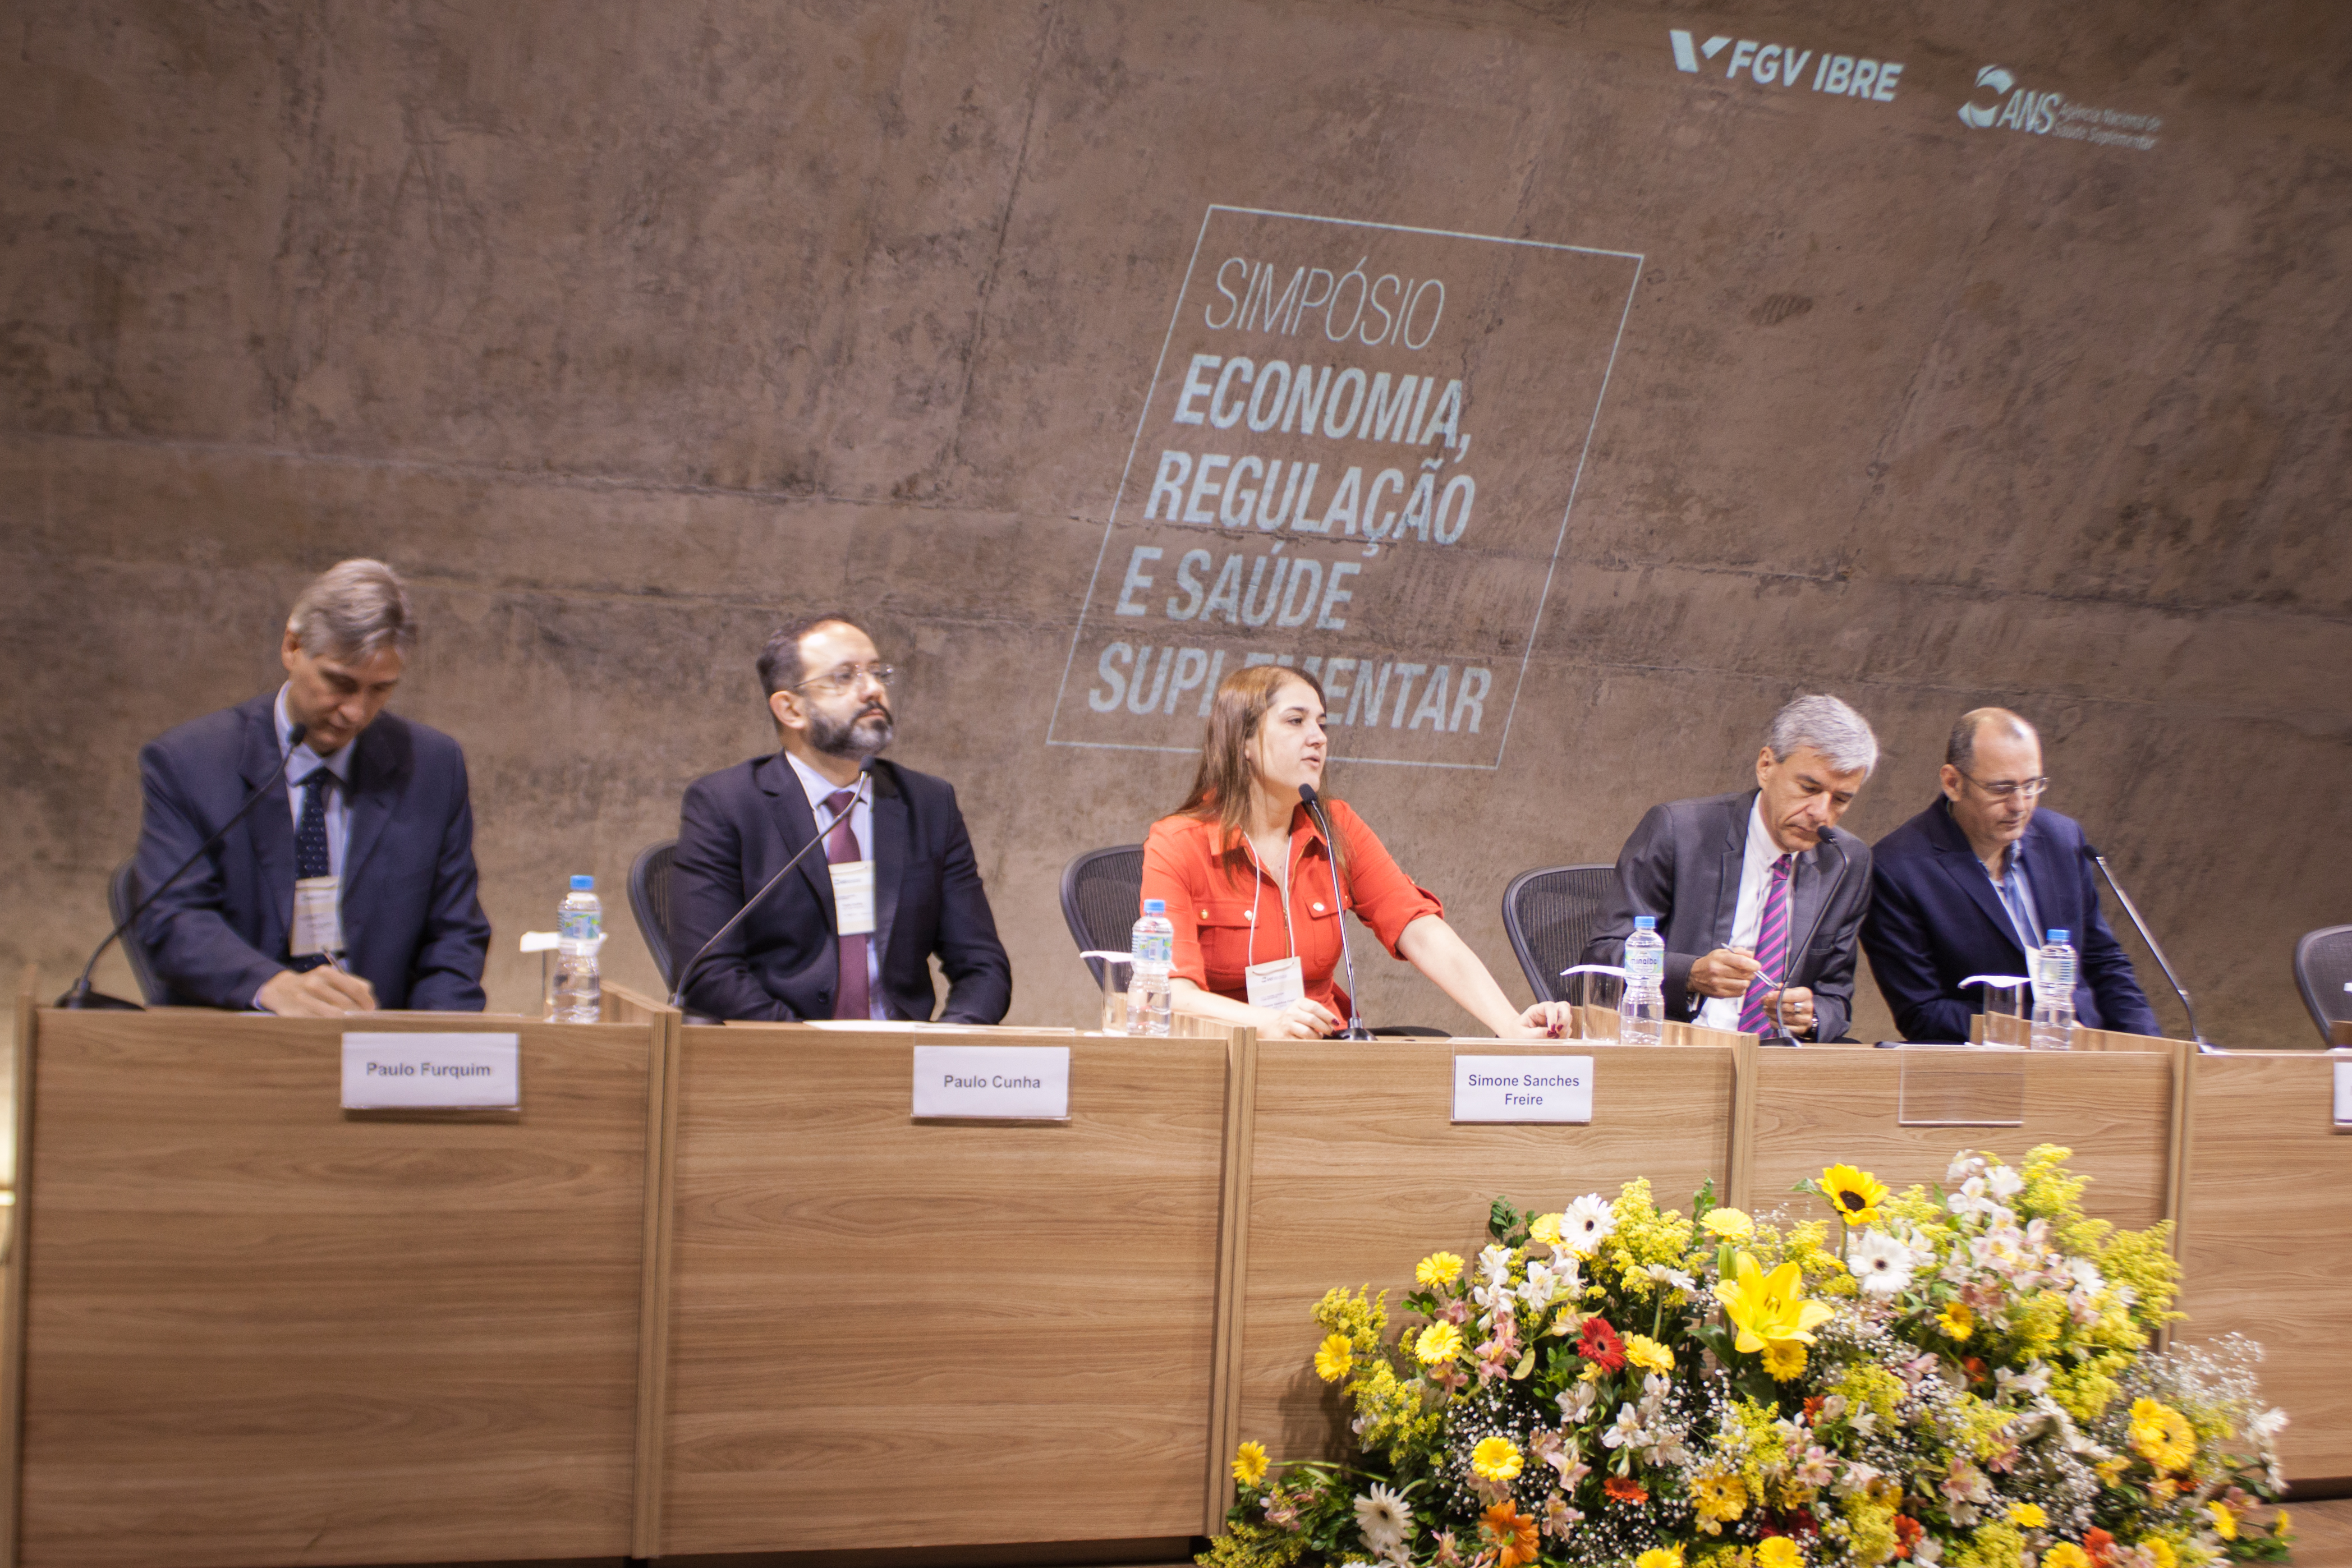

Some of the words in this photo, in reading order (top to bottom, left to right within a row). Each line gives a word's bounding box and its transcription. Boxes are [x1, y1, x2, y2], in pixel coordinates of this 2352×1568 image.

[1726, 40, 1812, 87] FGV
[1813, 53, 1904, 101] IBRE
[1996, 88, 2062, 134] ANS
[1205, 257, 1445, 350] SIMPÓSIO
[1173, 353, 1471, 462] ECONOMIA,
[1144, 450, 1476, 557] REGULAÇÃO
[1115, 545, 1163, 616] E
[1165, 540, 1361, 629] SAÚDE
[366, 1061, 414, 1076] Paulo
[420, 1061, 491, 1079] Furquim
[944, 1075, 987, 1088] Paulo
[992, 1075, 1041, 1088] Cunha
[1468, 1074, 1519, 1086] Simone
[1523, 1074, 1580, 1087] Sanches
[1505, 1093, 1543, 1105] Freire
